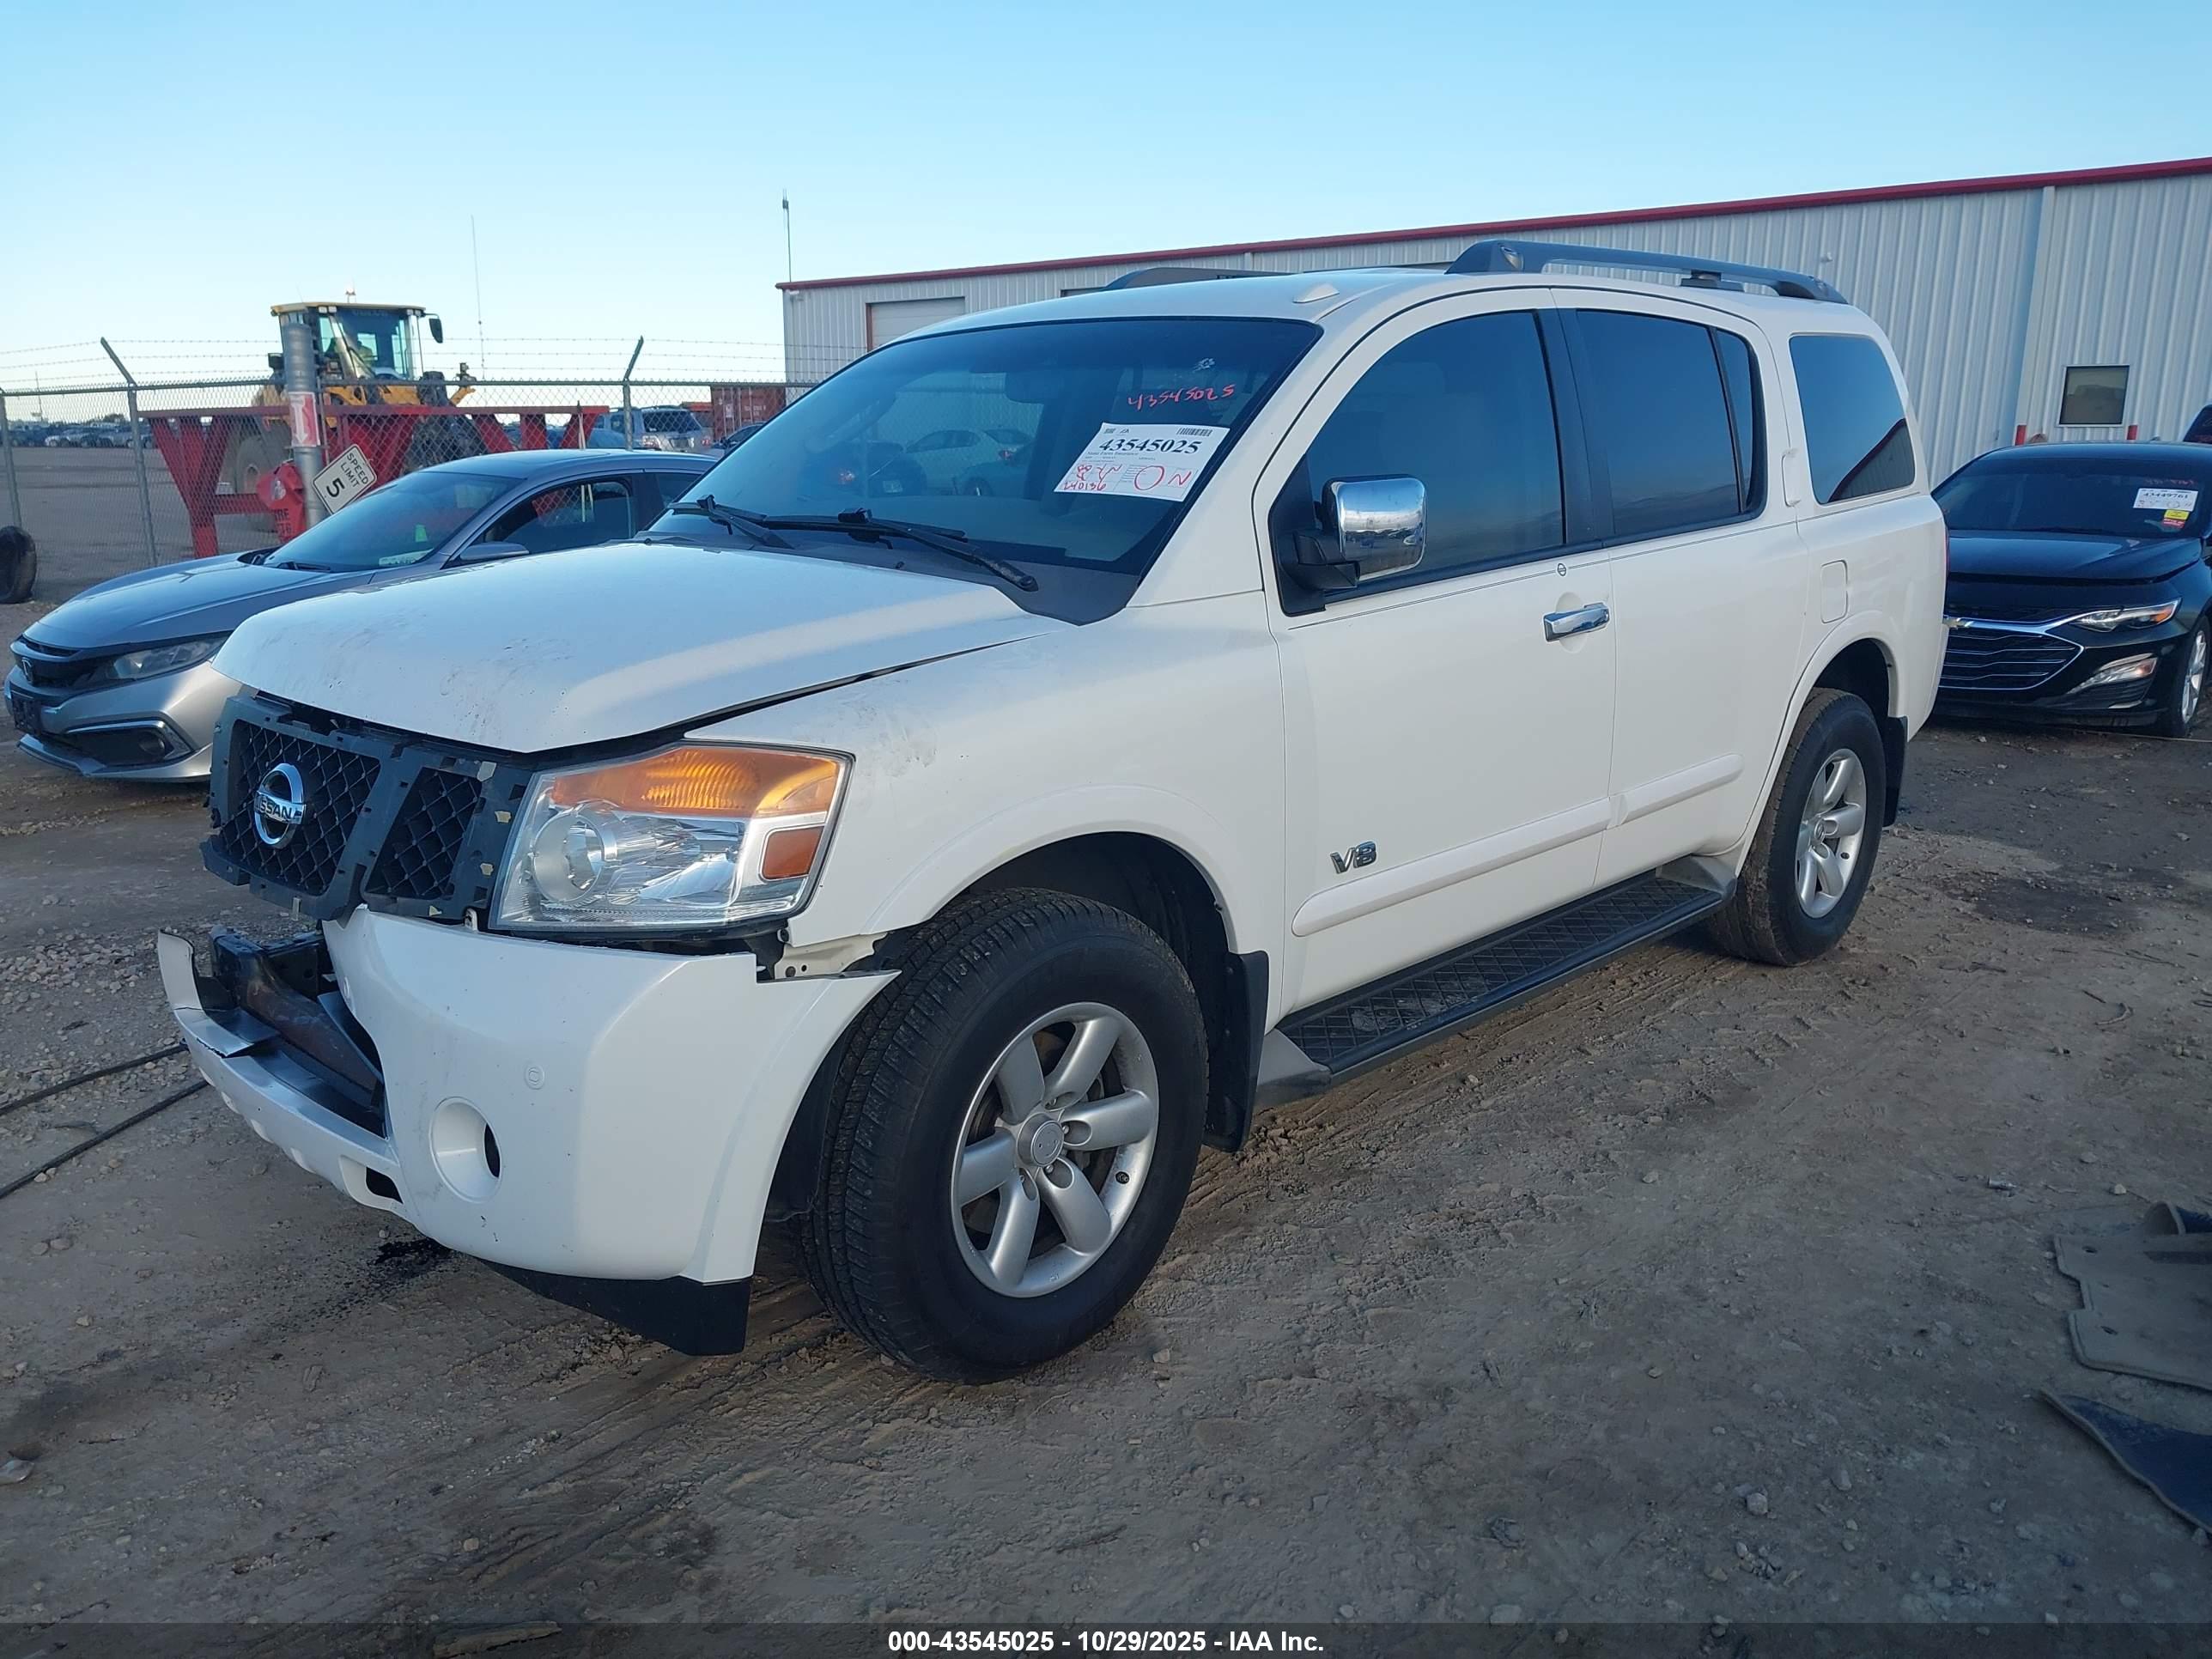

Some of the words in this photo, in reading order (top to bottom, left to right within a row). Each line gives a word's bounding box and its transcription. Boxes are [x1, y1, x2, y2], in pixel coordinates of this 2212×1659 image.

[1127, 384, 1236, 410] 43545025
[1099, 439, 1202, 453] 43545025
[340, 462, 360, 488] LIMIT
[346, 453, 369, 485] SPEED
[326, 477, 345, 498] 5
[1330, 841, 1377, 874] V8
